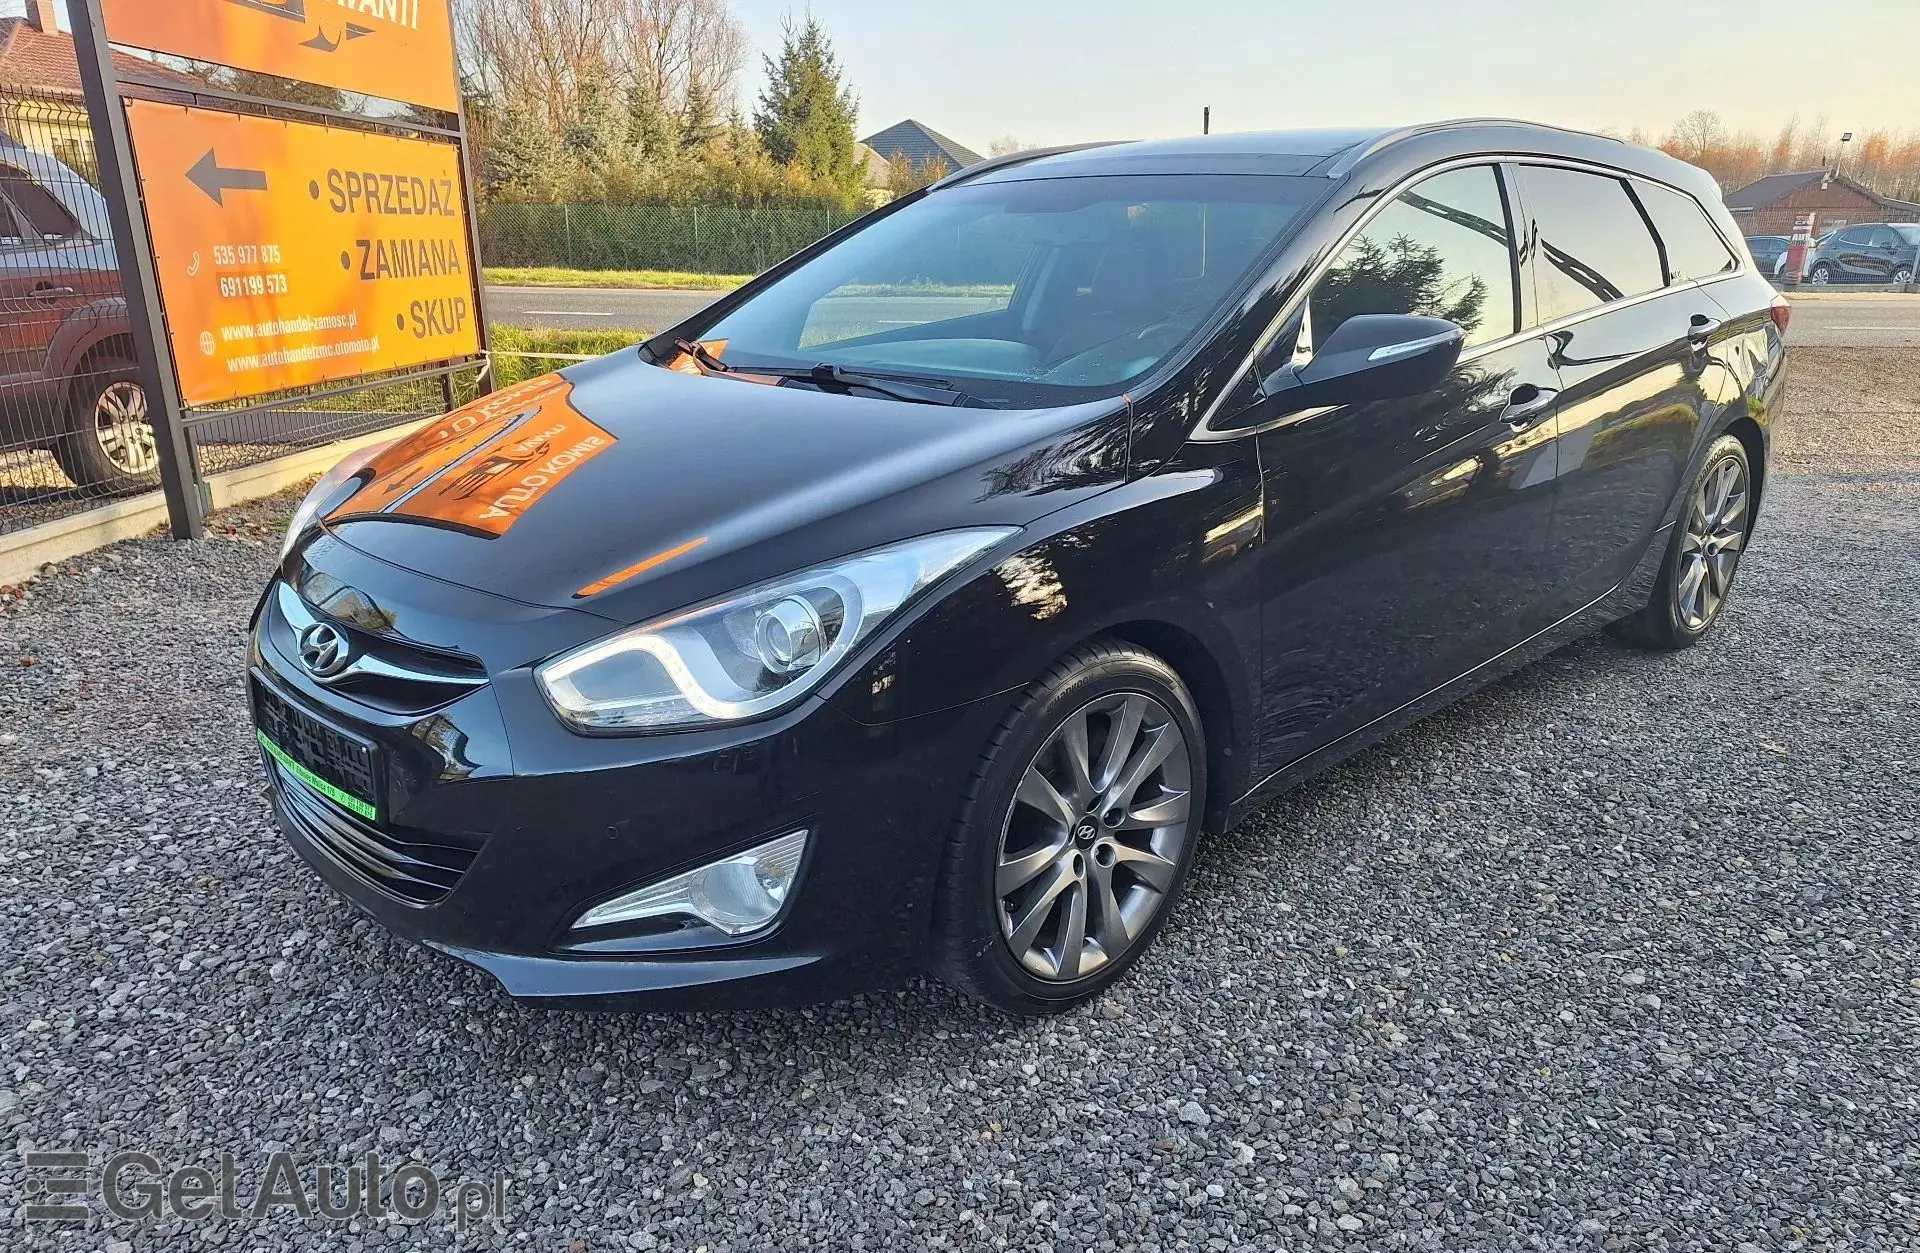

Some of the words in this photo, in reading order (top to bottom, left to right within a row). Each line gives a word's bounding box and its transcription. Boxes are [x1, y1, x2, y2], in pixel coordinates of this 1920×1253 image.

[327, 168, 455, 216] SPRZEDAŻ
[213, 245, 236, 264] 535
[238, 245, 257, 264] 977
[261, 244, 281, 264] 875
[356, 239, 461, 280] ZAMIANA
[266, 273, 287, 294] 573
[221, 308, 358, 341] www.autohandel-zamosc.pl
[410, 297, 466, 339] SKUP
[227, 335, 380, 372] www.autohandelzmc.otomoto.pl
